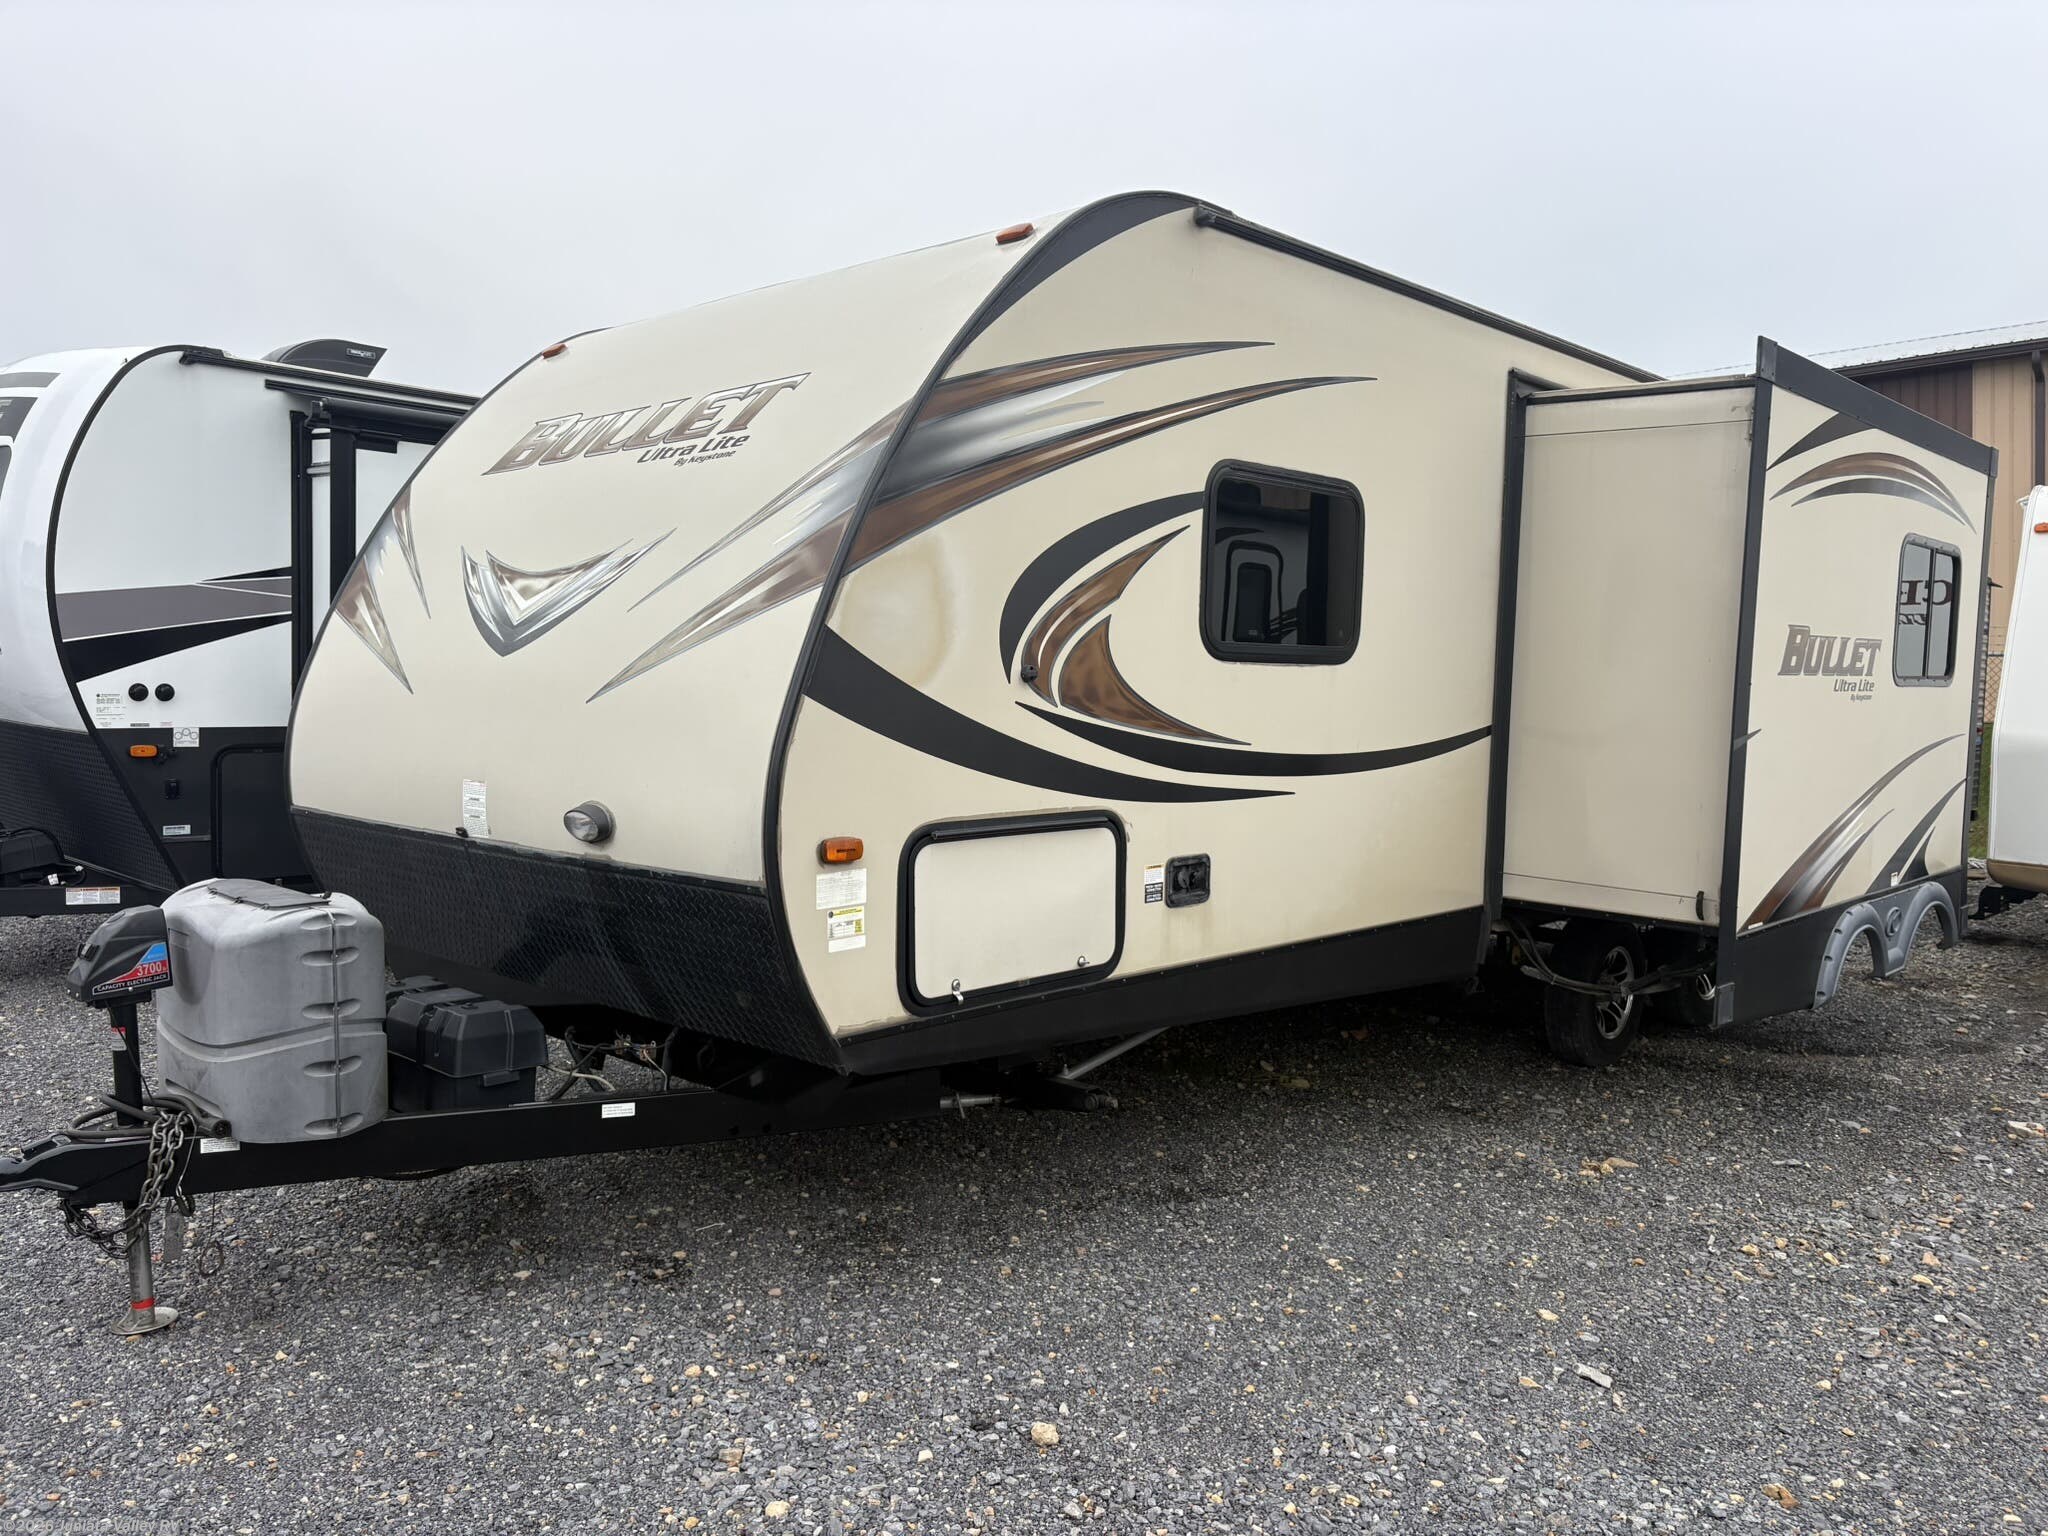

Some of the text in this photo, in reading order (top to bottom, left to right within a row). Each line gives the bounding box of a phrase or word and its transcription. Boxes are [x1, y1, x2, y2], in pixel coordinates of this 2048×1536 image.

[481, 372, 812, 476] BULLET
[637, 435, 750, 464] Ultra Lite
[1777, 624, 1882, 677] BULLET
[1833, 679, 1875, 692] Ultra Lite
[137, 961, 162, 976] 3700
[97, 982, 126, 991] CAPACITY
[126, 976, 152, 987] ELECTRIC
